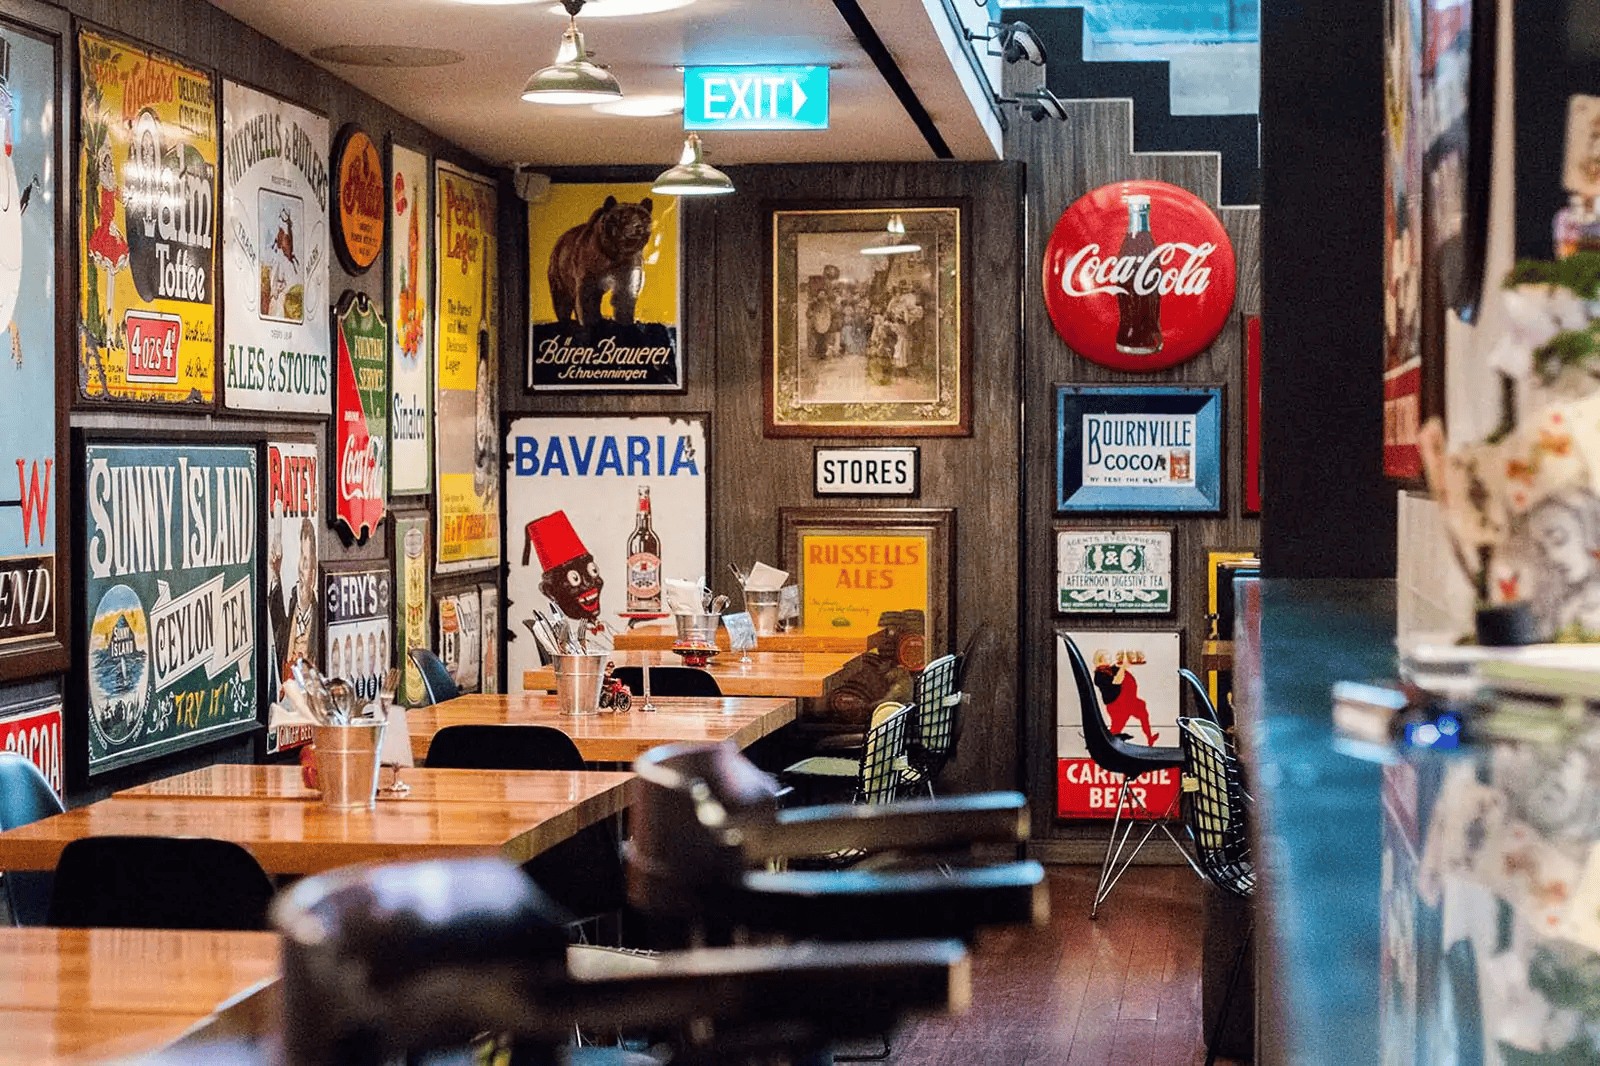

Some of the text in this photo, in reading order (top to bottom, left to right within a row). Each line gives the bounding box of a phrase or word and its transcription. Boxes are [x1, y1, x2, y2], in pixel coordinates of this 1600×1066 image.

[703, 78, 785, 119] EXIT
[155, 242, 206, 301] Toffee
[1062, 241, 1218, 297] Coca-Cola
[131, 325, 141, 370] 4
[227, 345, 265, 391] ALES
[268, 357, 276, 392] &
[278, 350, 327, 396] STOUTS
[393, 392, 425, 440] Sinalco
[515, 435, 700, 477] BAVARIA
[1088, 418, 1192, 466] BOURNVILLE
[1104, 453, 1167, 472] COCOA
[823, 459, 907, 485] STORES
[89, 456, 255, 579] SUNNY ISLAND
[340, 574, 378, 617] FRY'S
[835, 568, 894, 590] ALES
[1066, 575, 1164, 587] AFTERNOON DIGESTIVE TEA
[155, 589, 249, 680] CEYLON TEA
[174, 691, 206, 729] TRY
